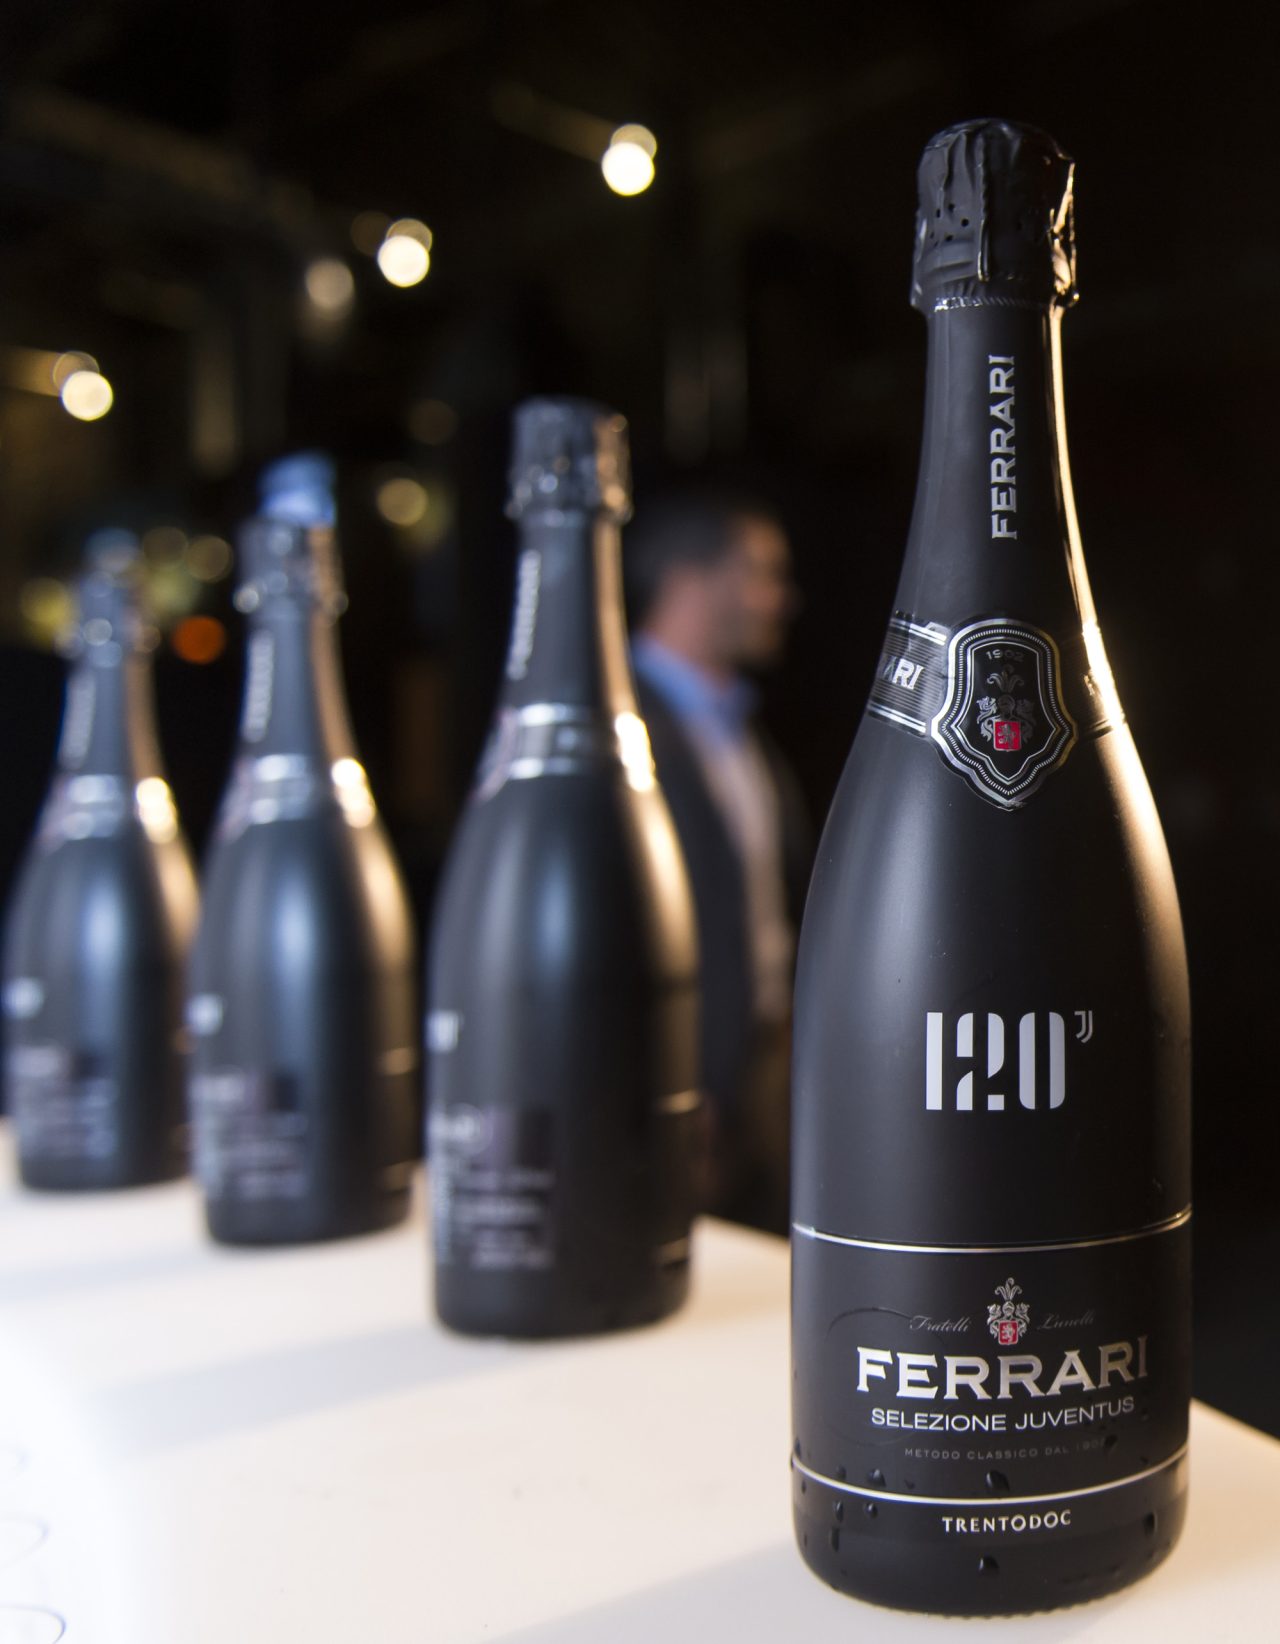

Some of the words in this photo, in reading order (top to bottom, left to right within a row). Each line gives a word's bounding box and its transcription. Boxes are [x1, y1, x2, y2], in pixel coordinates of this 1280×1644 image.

[988, 354, 1017, 540] FERRARI
[926, 1011, 1066, 1111] 120
[909, 1314, 972, 1333] Fratelli
[855, 1334, 1149, 1400] FERRARI
[870, 1407, 1007, 1432] SELEZIONE
[1014, 1396, 1135, 1431] JUVENTUS
[904, 1447, 961, 1460] METODO
[966, 1447, 1039, 1460] CLASSICO
[1045, 1445, 1069, 1457] DAL
[941, 1508, 1072, 1533] TRENTODOC
